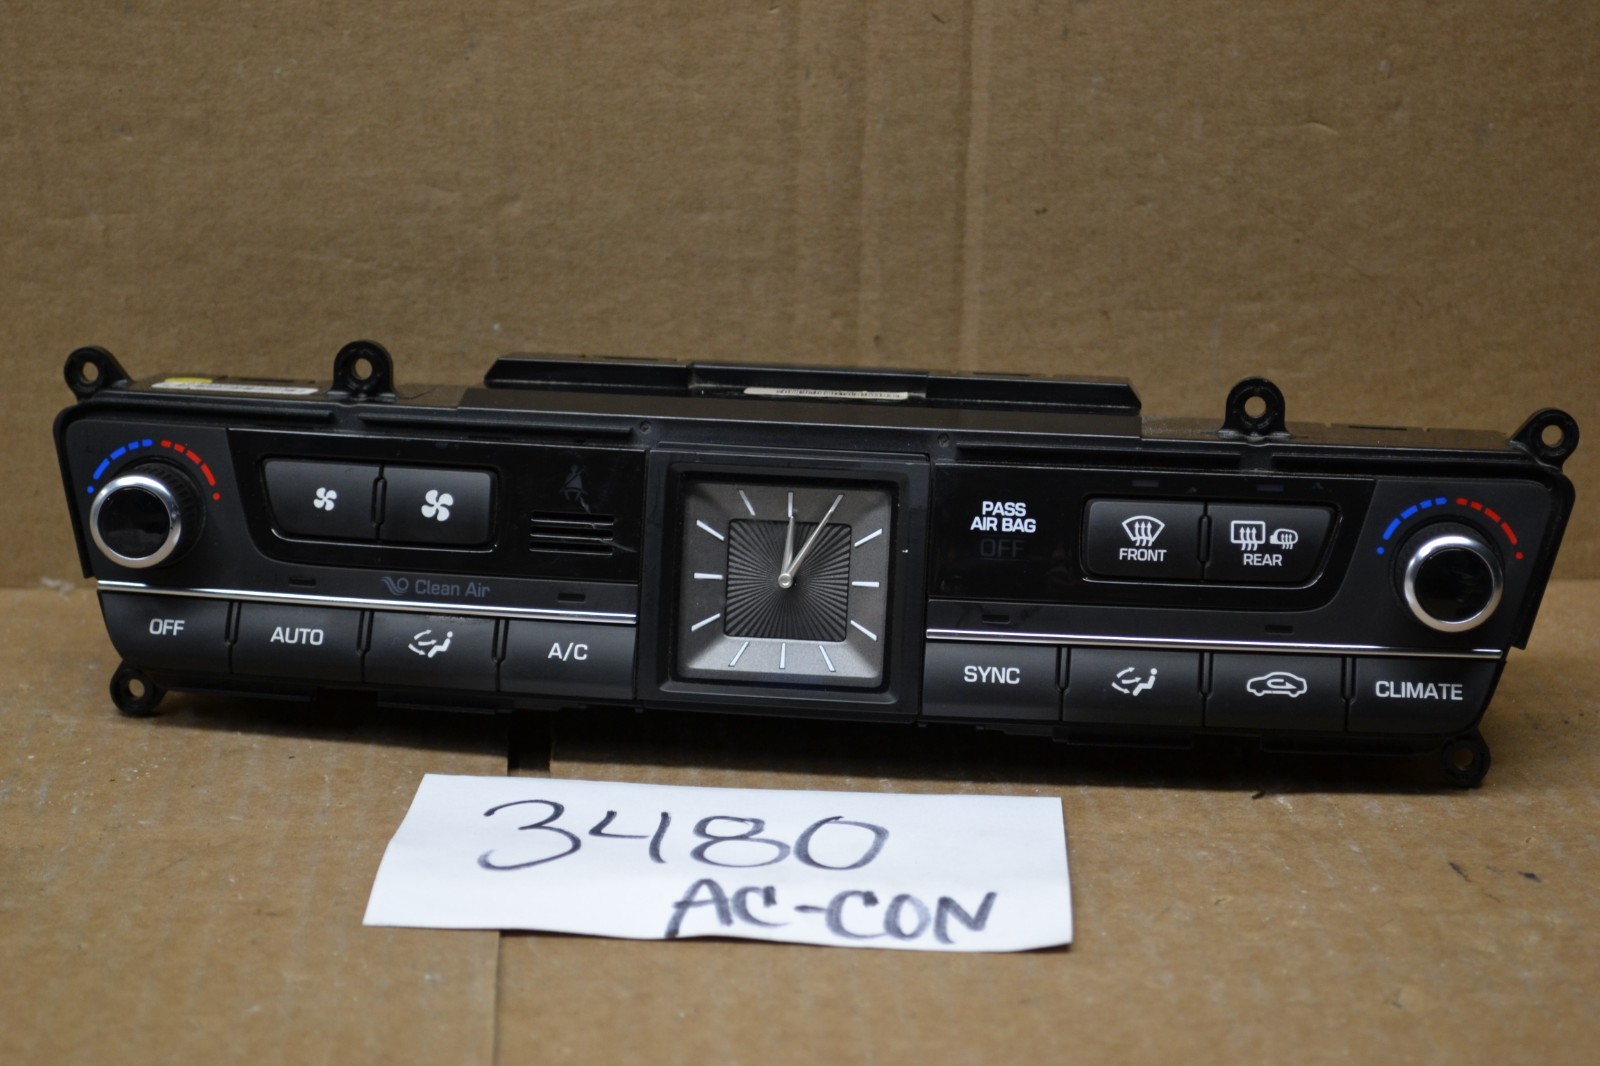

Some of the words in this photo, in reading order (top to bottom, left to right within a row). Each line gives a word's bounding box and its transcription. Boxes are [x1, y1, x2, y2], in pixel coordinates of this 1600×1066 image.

[981, 500, 1027, 517] PASS
[969, 515, 999, 532] AIR
[1001, 516, 1037, 534] BAG
[1118, 548, 1167, 563] FRONT
[1242, 553, 1283, 568] REAR
[414, 578, 460, 597] Clean
[463, 581, 491, 599] Air
[148, 618, 185, 636] OFF
[270, 626, 324, 646] AUTO
[547, 642, 589, 662] A/C
[963, 665, 1021, 686] SYNC
[1374, 680, 1464, 702] CLIMATE
[477, 799, 891, 871] 3480
